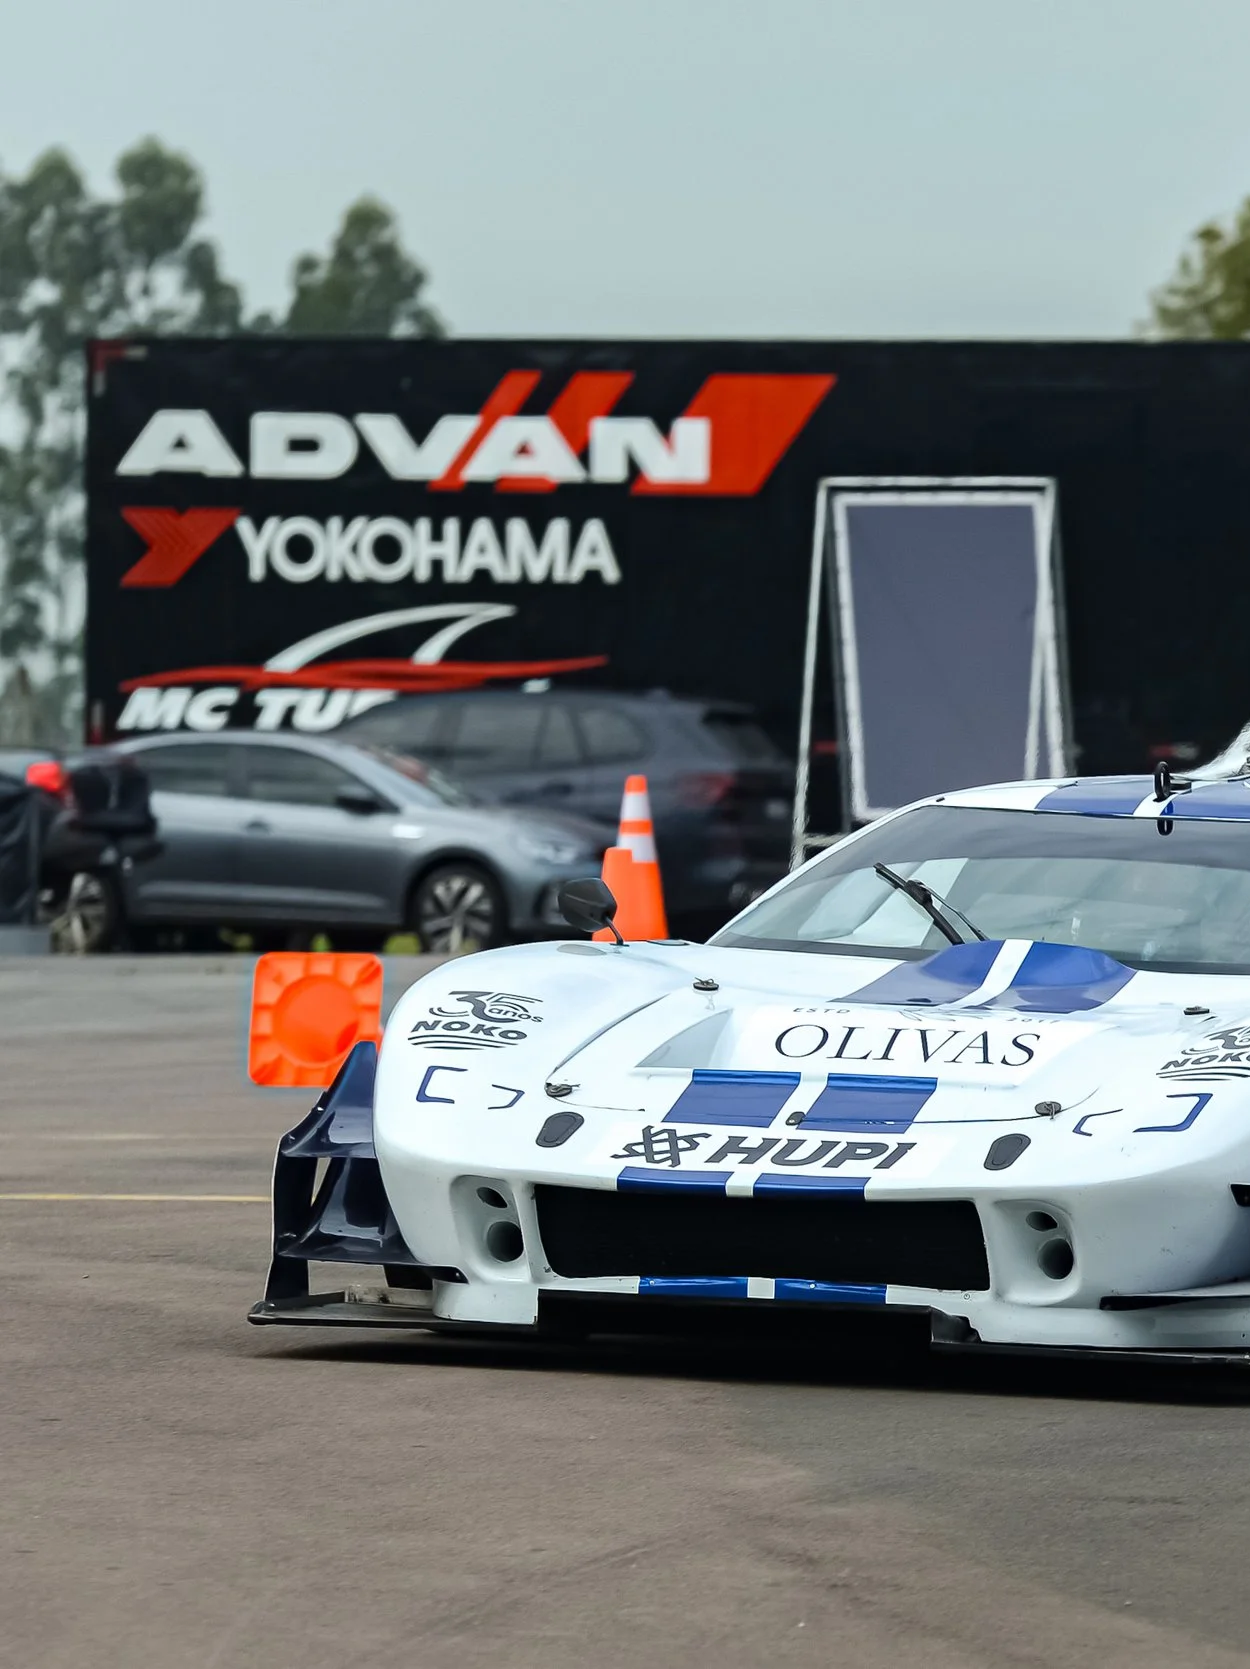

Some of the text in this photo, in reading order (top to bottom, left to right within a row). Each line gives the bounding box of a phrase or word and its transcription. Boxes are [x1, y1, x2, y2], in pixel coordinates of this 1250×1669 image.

[117, 409, 711, 484] ADVAN
[234, 516, 622, 584] YOKOHAMA
[116, 687, 240, 731] MC
[411, 1019, 528, 1041] NOKO
[488, 1006, 544, 1023] anos
[774, 1023, 1041, 1067] OLIVAS
[704, 1135, 917, 1170] HUPI
